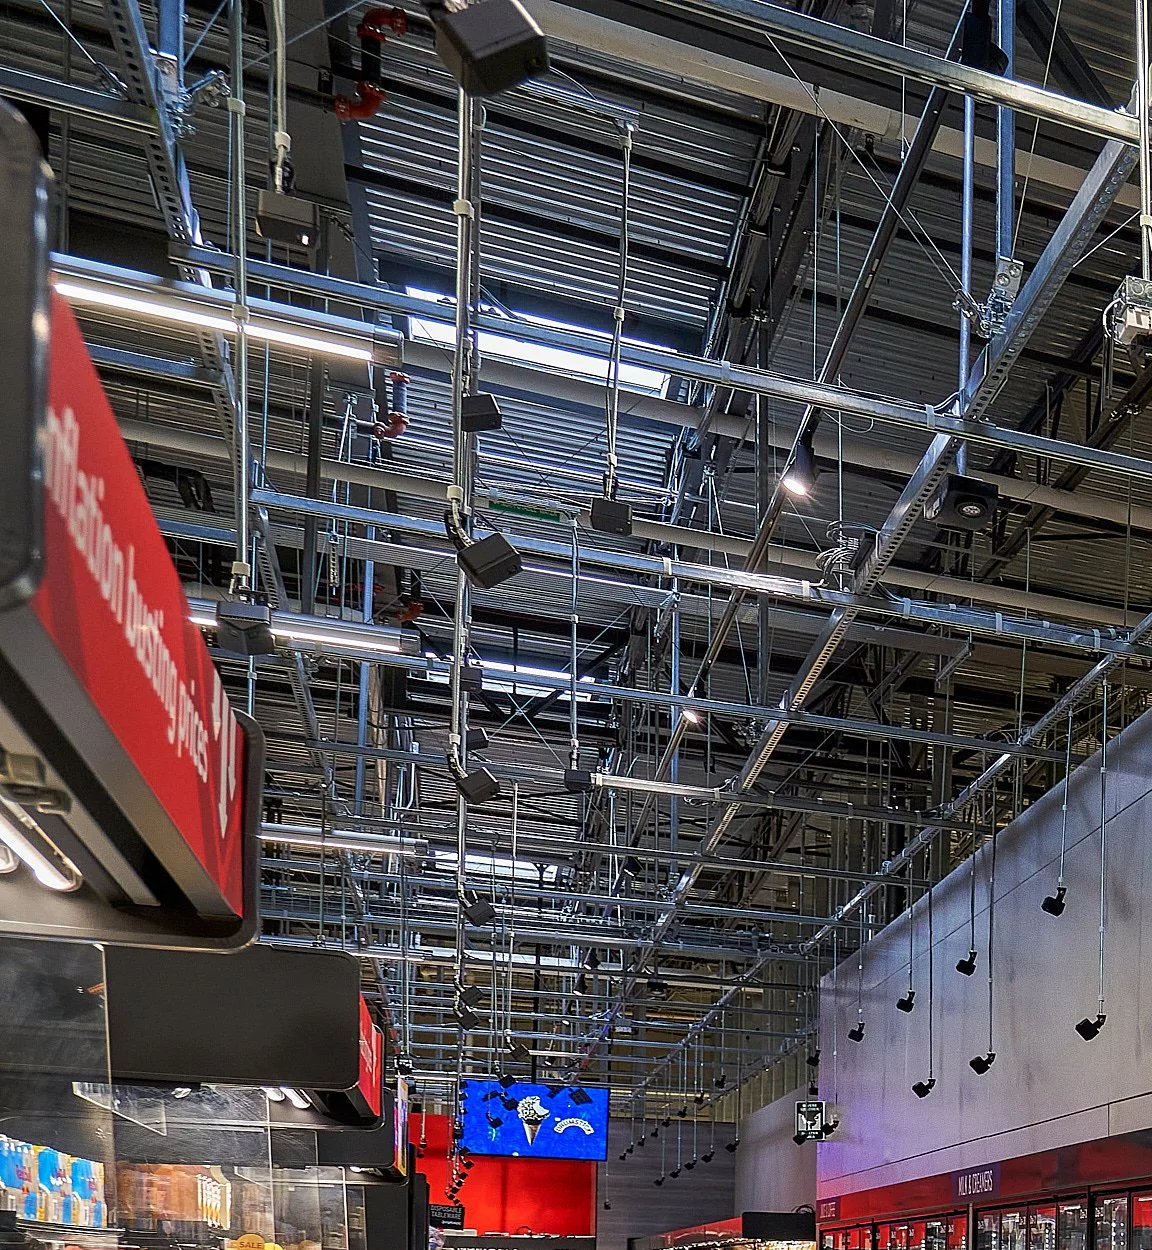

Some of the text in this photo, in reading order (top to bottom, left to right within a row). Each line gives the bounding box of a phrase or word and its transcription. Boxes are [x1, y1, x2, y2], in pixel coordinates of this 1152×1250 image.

[44, 406, 208, 784] nflation busting prices
[240, 1241, 262, 1249] SALE
